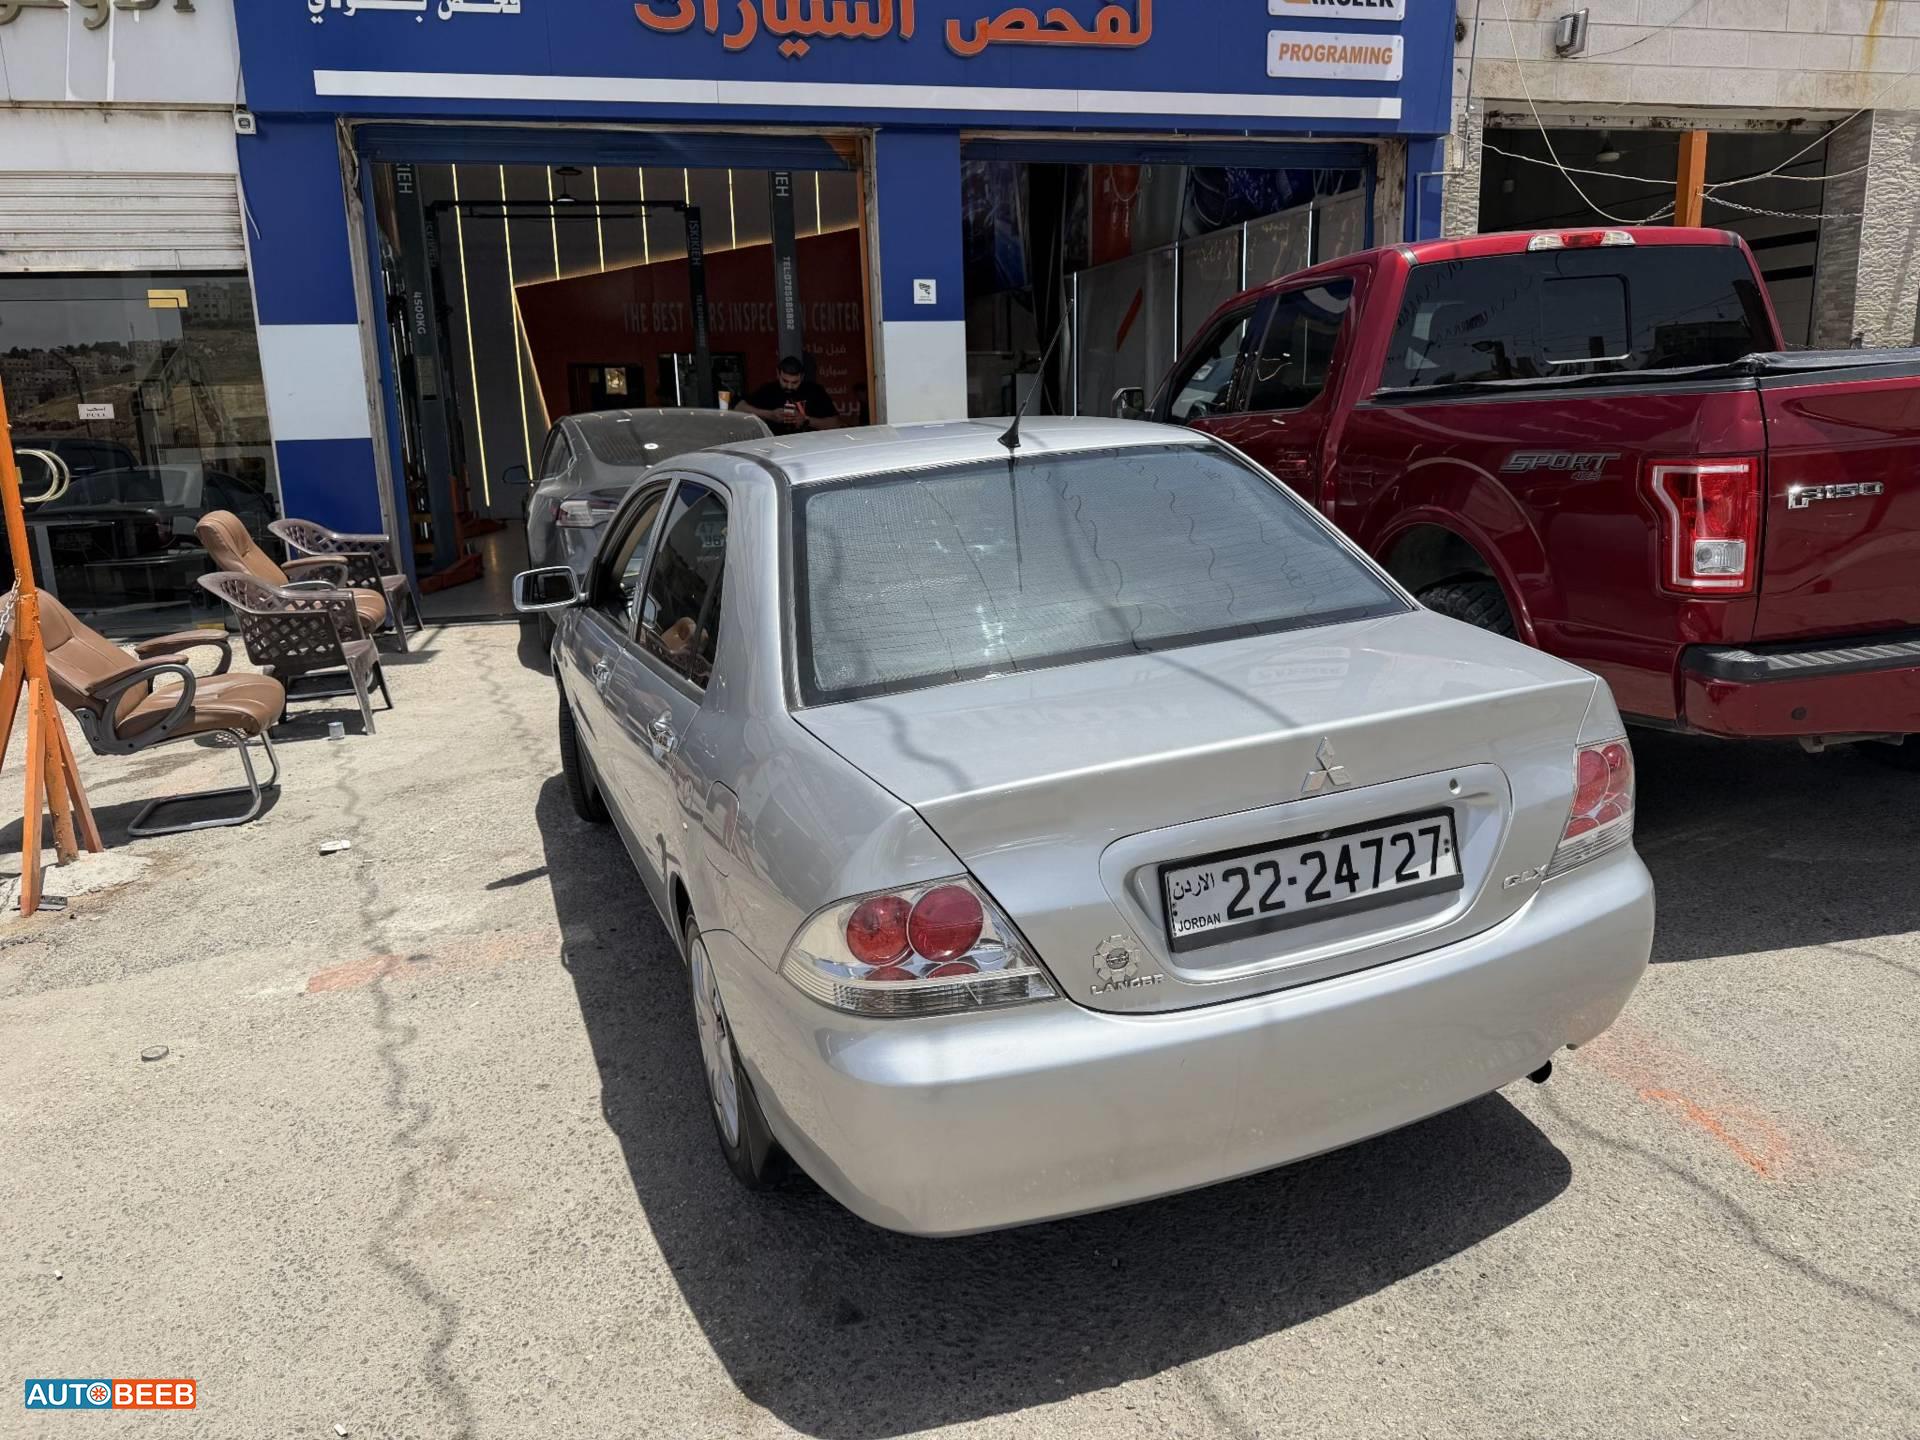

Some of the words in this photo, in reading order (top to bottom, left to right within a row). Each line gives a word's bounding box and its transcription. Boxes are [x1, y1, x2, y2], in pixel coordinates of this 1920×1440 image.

[1278, 42, 1393, 65] PROGRAMING
[413, 291, 427, 335] 4500KG
[624, 302, 648, 334] THE
[652, 302, 683, 333] BEST
[812, 302, 860, 333] CENTER
[1499, 450, 1621, 474] SPORT
[1503, 863, 1549, 890] GLX
[1178, 912, 1221, 932] JORDAN
[1090, 973, 1164, 995] LANCER
